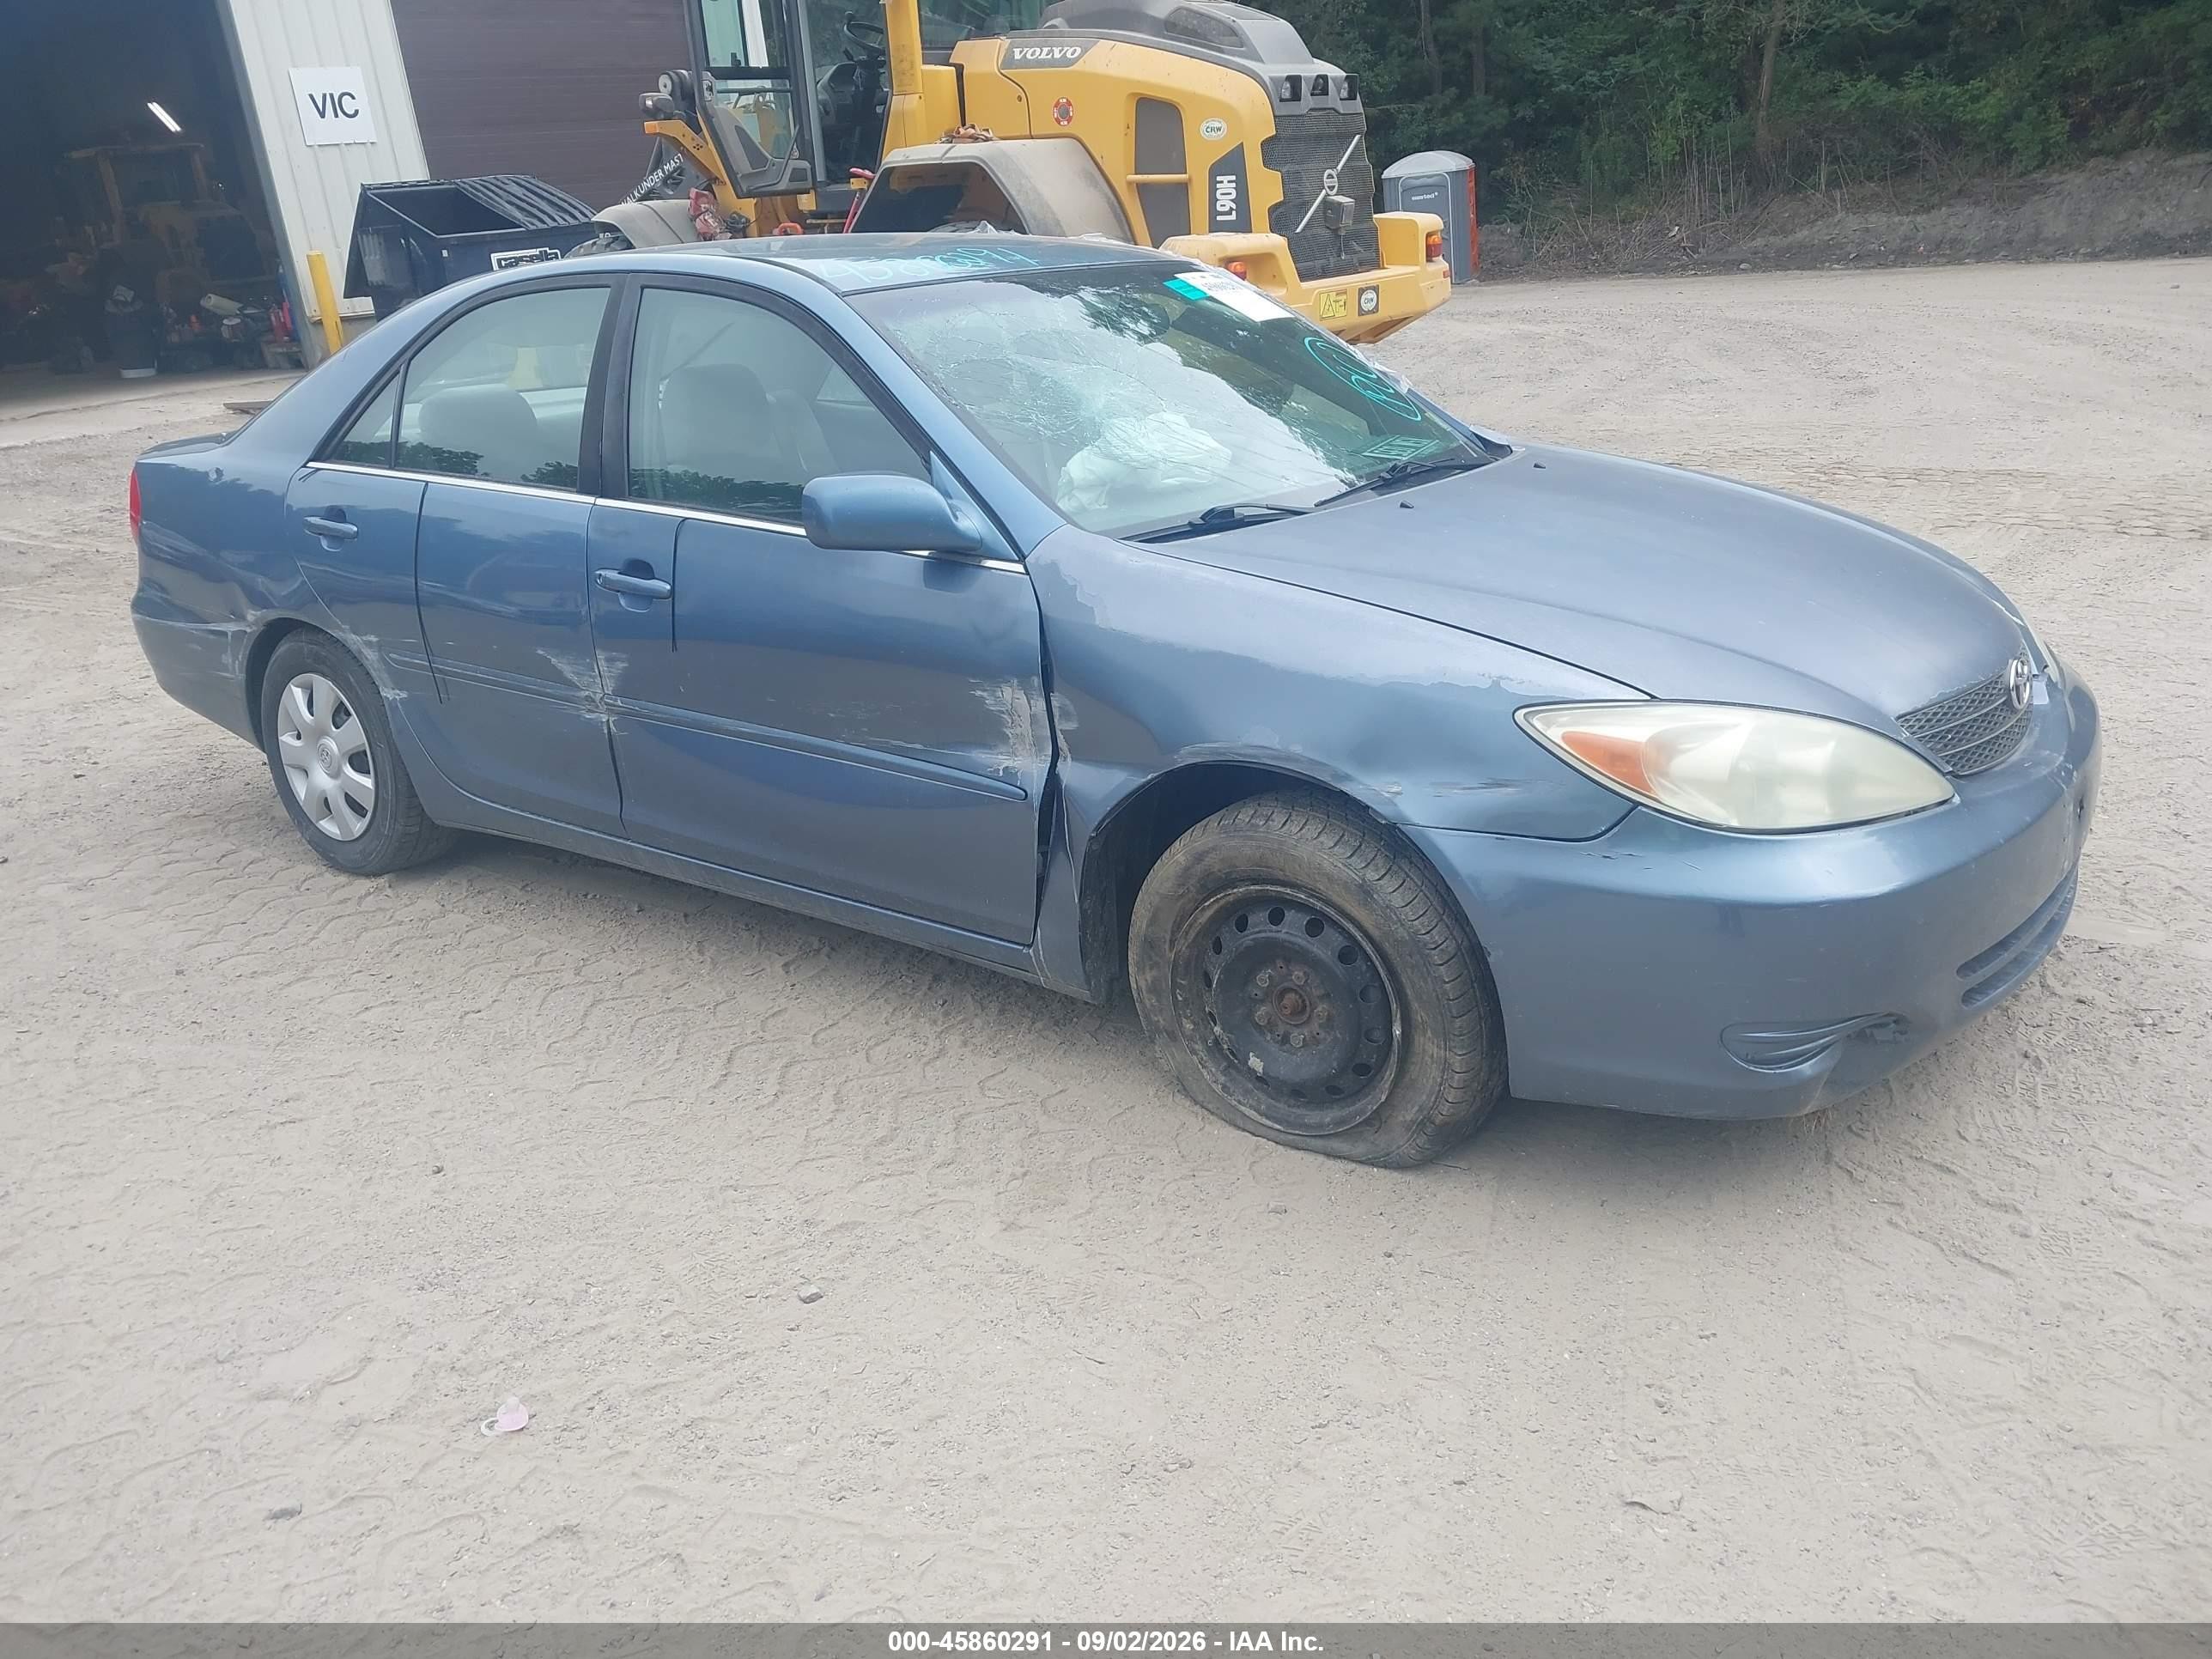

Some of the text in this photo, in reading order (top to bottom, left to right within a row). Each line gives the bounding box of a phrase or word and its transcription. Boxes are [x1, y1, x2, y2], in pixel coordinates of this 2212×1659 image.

[1012, 46, 1082, 59] VOLVO
[307, 91, 360, 118] VIC
[638, 168, 664, 194] UNDER
[663, 153, 684, 174] MAST
[1216, 174, 1237, 221] L90H
